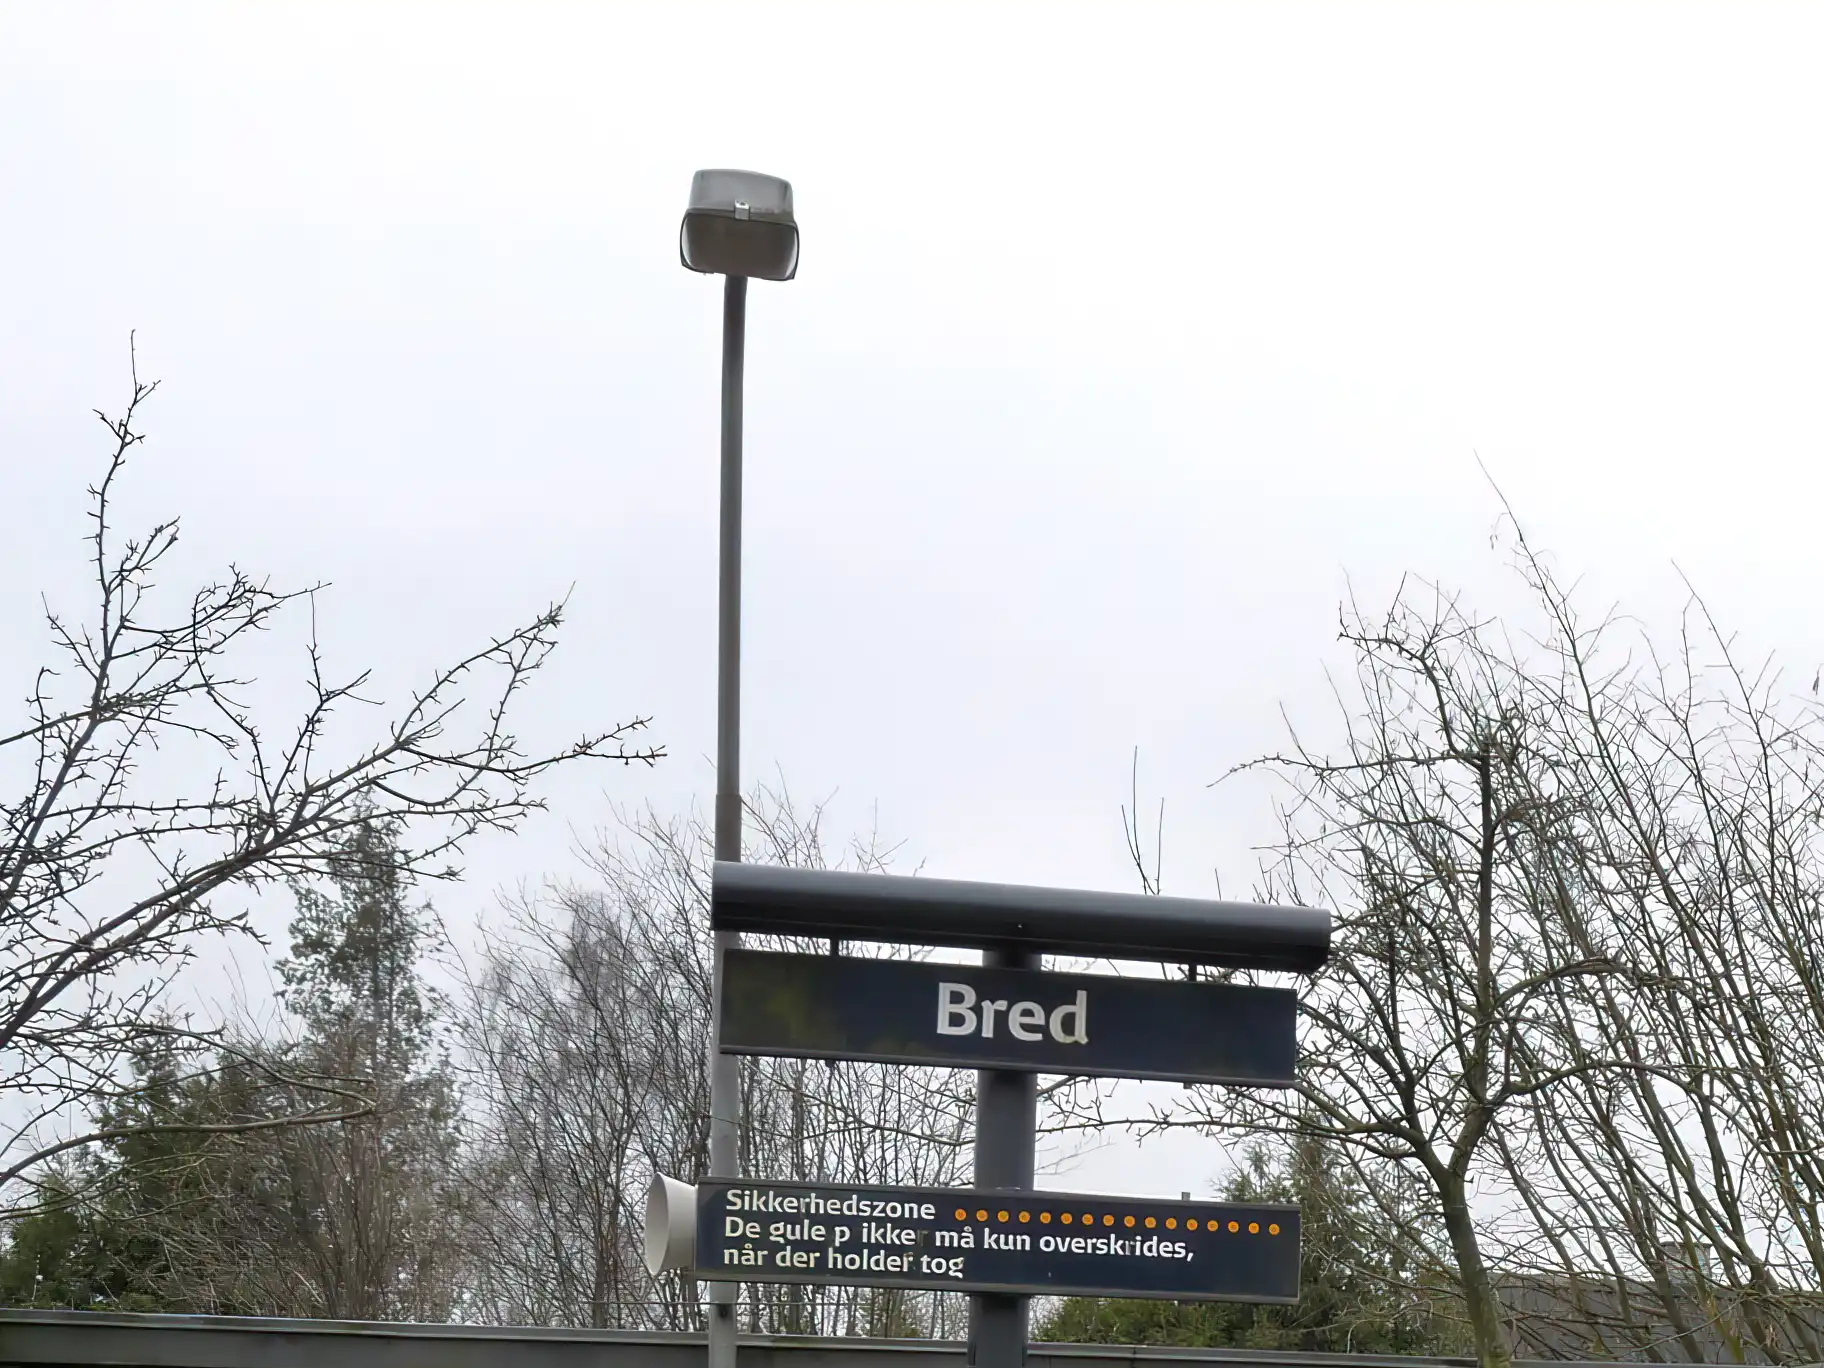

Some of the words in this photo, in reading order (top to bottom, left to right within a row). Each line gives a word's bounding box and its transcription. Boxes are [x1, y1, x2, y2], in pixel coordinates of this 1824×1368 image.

[936, 982, 1089, 1045] Bred
[725, 1189, 936, 1220] Sikkerhedszone
[725, 1216, 761, 1238] De
[769, 1219, 826, 1244] gule
[935, 1226, 975, 1249] må
[983, 1227, 1031, 1251] kun
[1039, 1233, 1194, 1262] overskrides,
[723, 1244, 768, 1266] når
[775, 1246, 821, 1269] der
[827, 1246, 914, 1272] holder
[921, 1254, 965, 1279] tog
